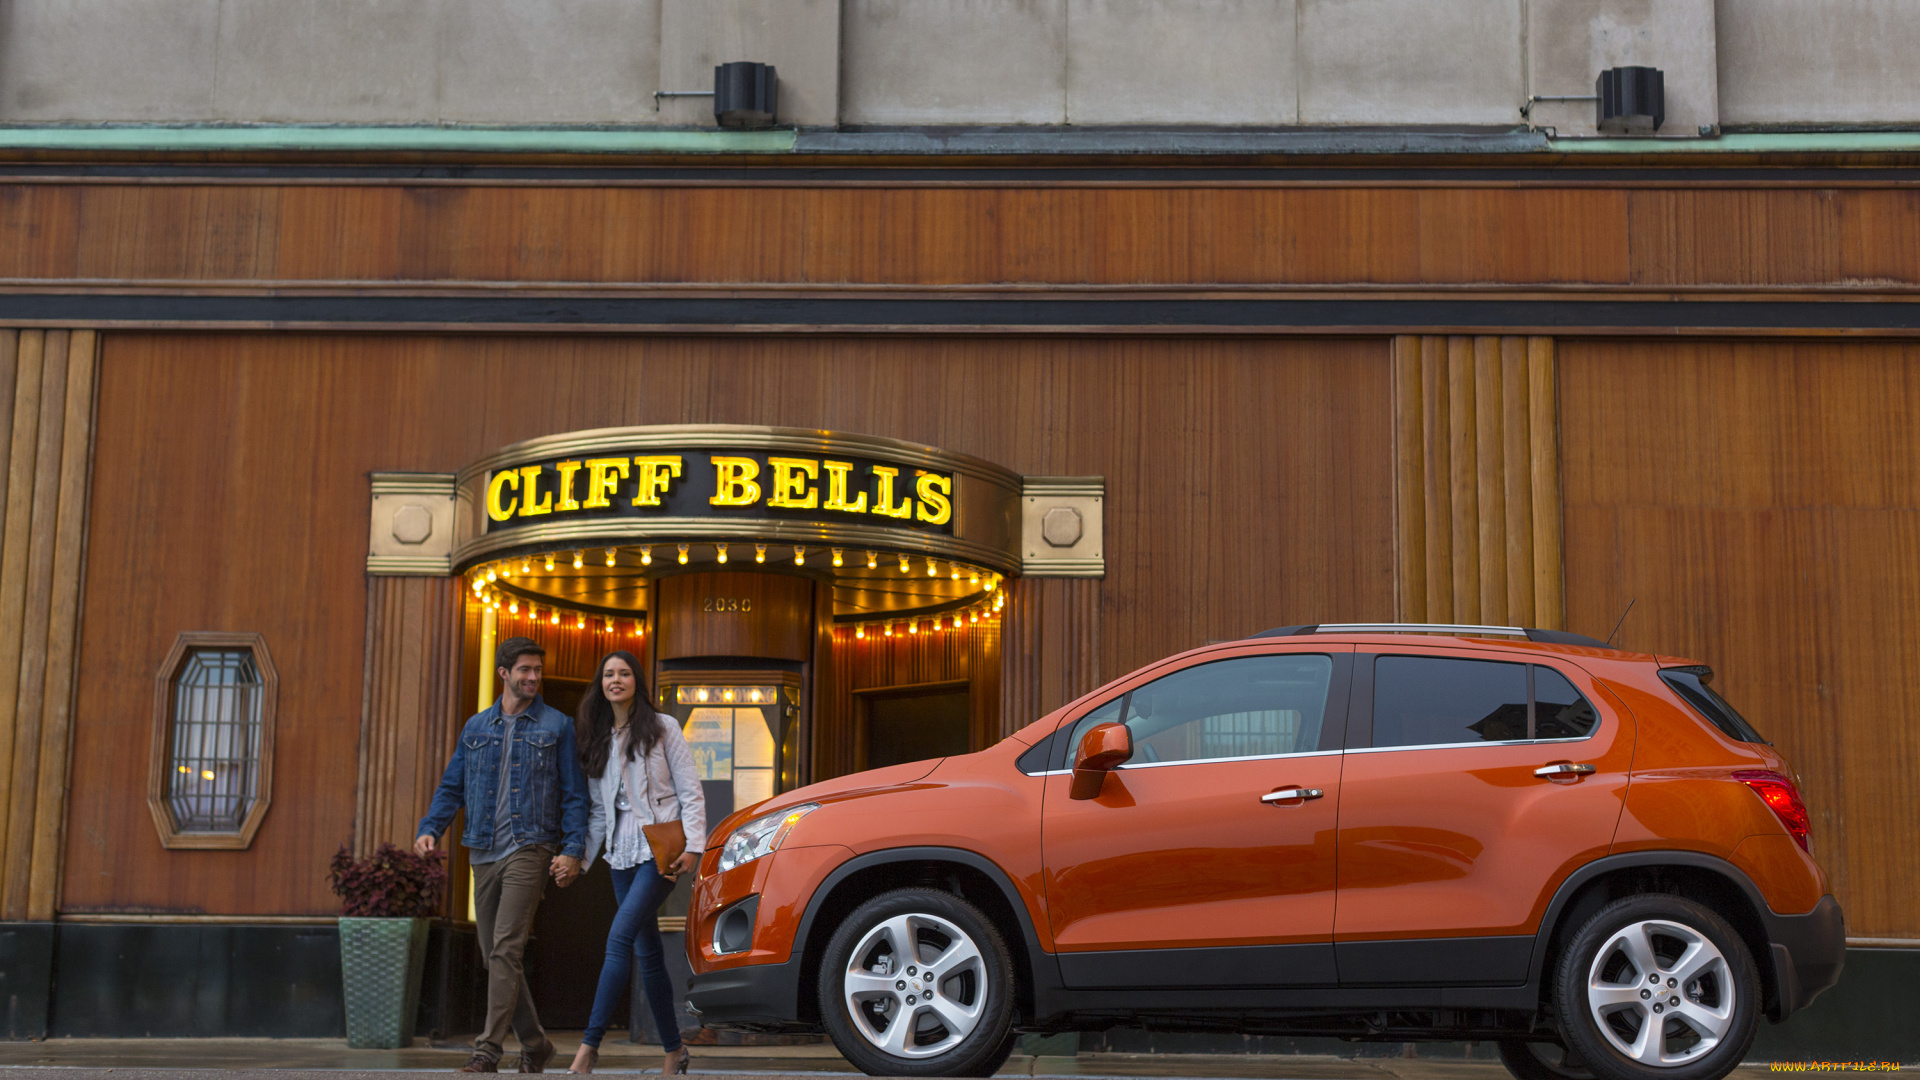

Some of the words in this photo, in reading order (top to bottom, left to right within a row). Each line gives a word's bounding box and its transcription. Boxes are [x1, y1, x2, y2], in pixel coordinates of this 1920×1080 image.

[486, 455, 682, 521] CLIFF
[710, 455, 952, 525] BELLS
[704, 598, 751, 611] 2030
[714, 688, 775, 703] SHOWNG
